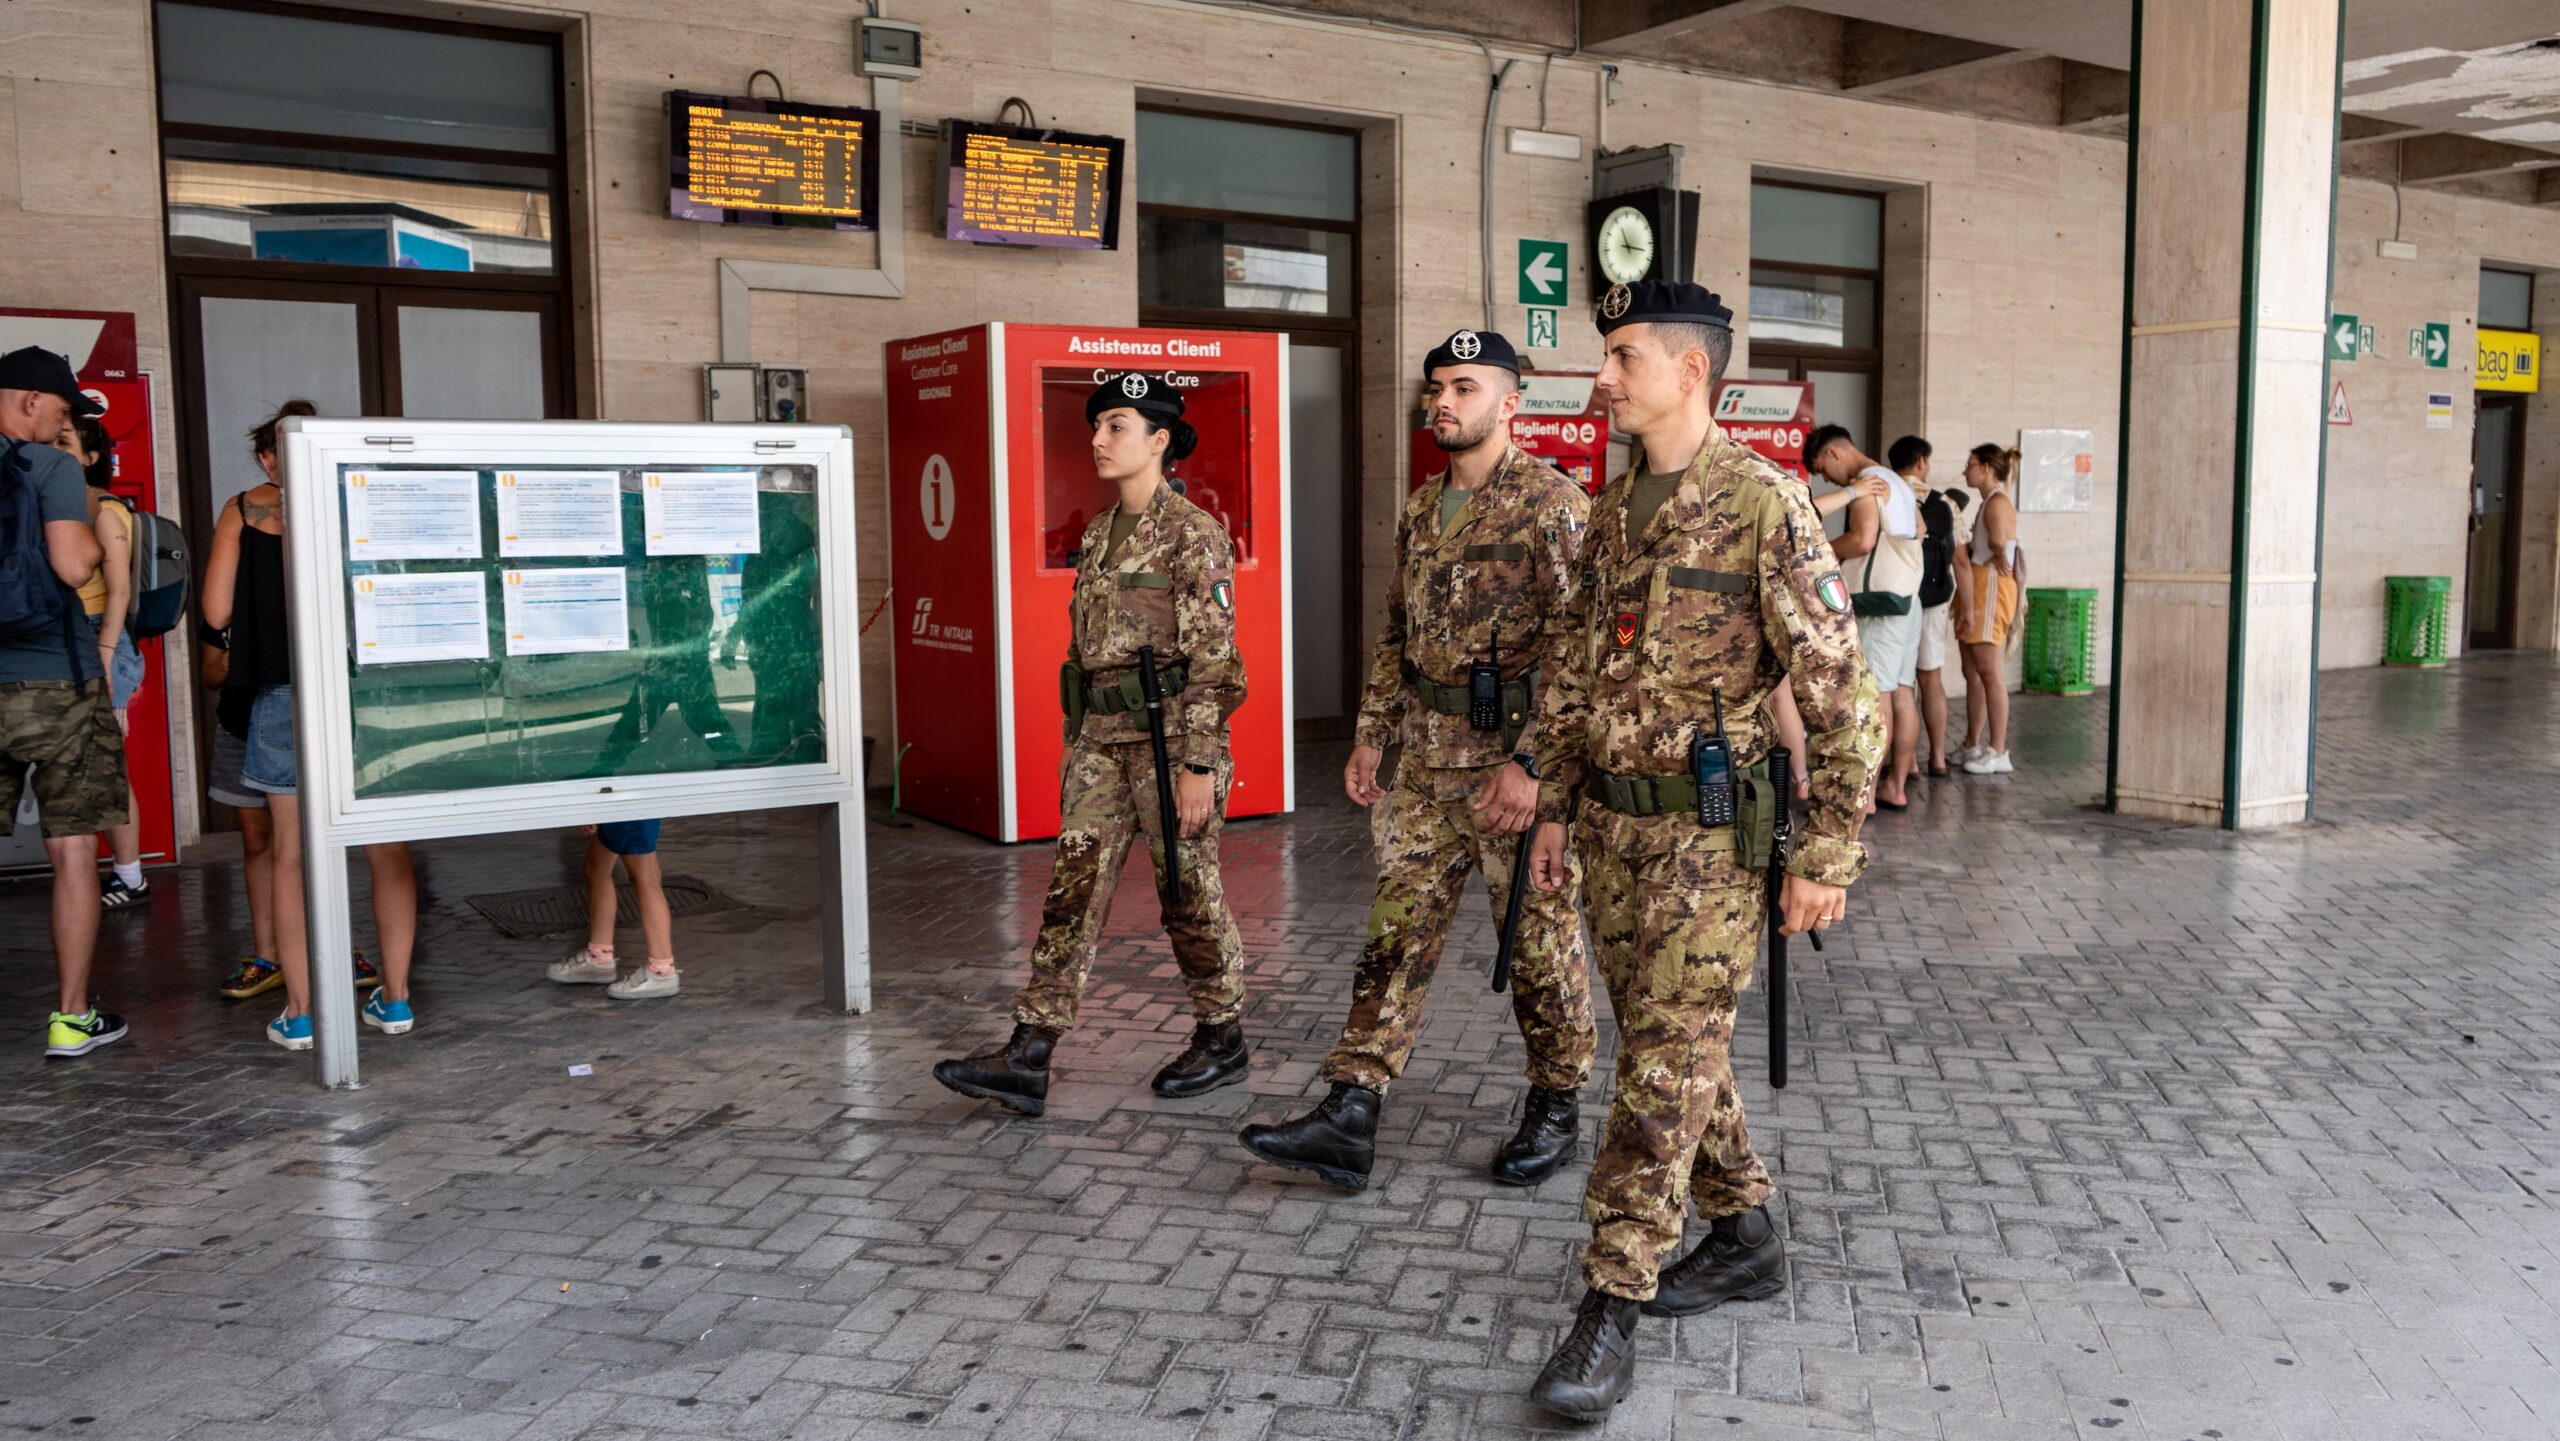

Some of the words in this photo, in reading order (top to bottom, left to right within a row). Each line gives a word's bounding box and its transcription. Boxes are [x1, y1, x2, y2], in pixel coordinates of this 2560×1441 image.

[688, 105, 723, 118] ARRIVI
[688, 162, 704, 170] REG
[731, 165, 761, 174] TERMINI
[688, 184, 704, 193] REG
[901, 344, 941, 361] Assistenza
[942, 336, 969, 355] Clienti
[1068, 336, 1163, 356] Assistenza
[1167, 340, 1222, 358] Clienti
[2477, 341, 2509, 381] bag
[104, 370, 126, 378] 0662
[911, 364, 941, 381] Customer
[941, 360, 959, 377] Care
[1165, 370, 1200, 387] Care
[1524, 399, 1581, 410] TRENITALIA
[1742, 406, 1790, 416] TRENITALIA
[1512, 421, 1560, 438] Biglietti
[1730, 426, 1772, 443] Biglietti
[1819, 574, 1840, 587] ITALIA
